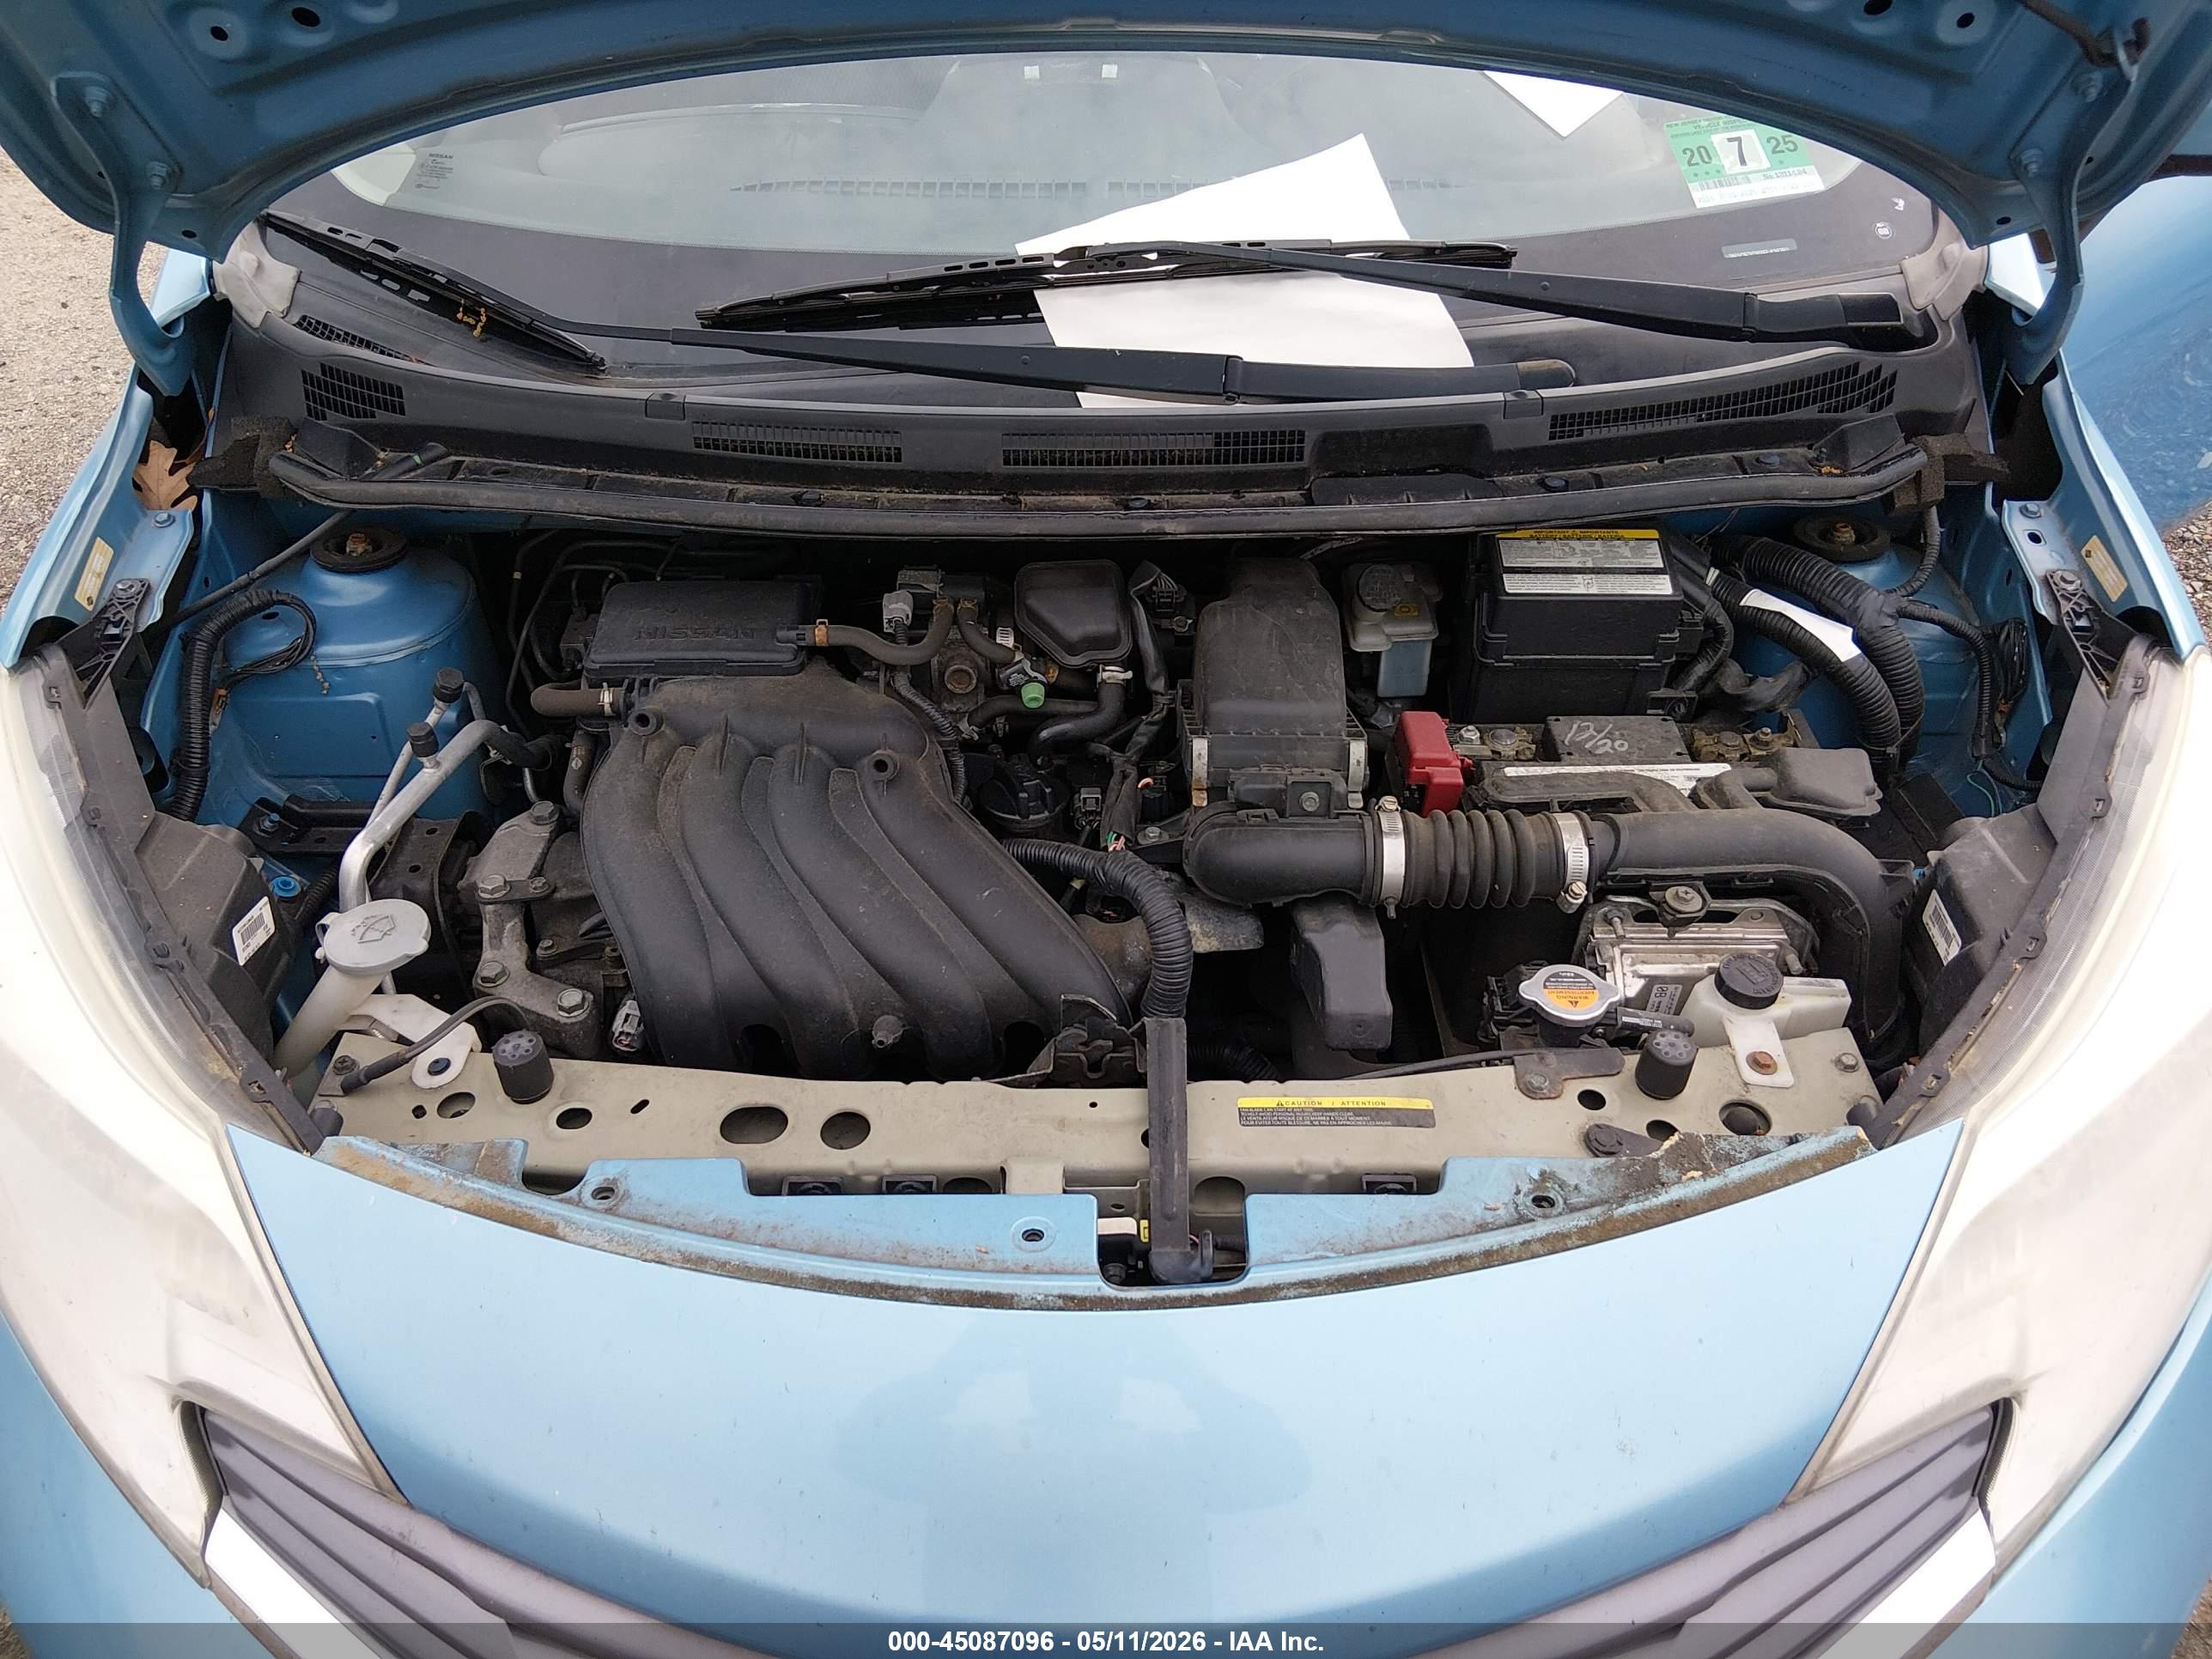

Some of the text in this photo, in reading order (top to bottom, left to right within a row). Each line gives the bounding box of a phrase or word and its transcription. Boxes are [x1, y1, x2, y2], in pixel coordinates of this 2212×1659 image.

[1682, 134, 1798, 167] 20 7 25
[634, 625, 755, 640] NISSAN
